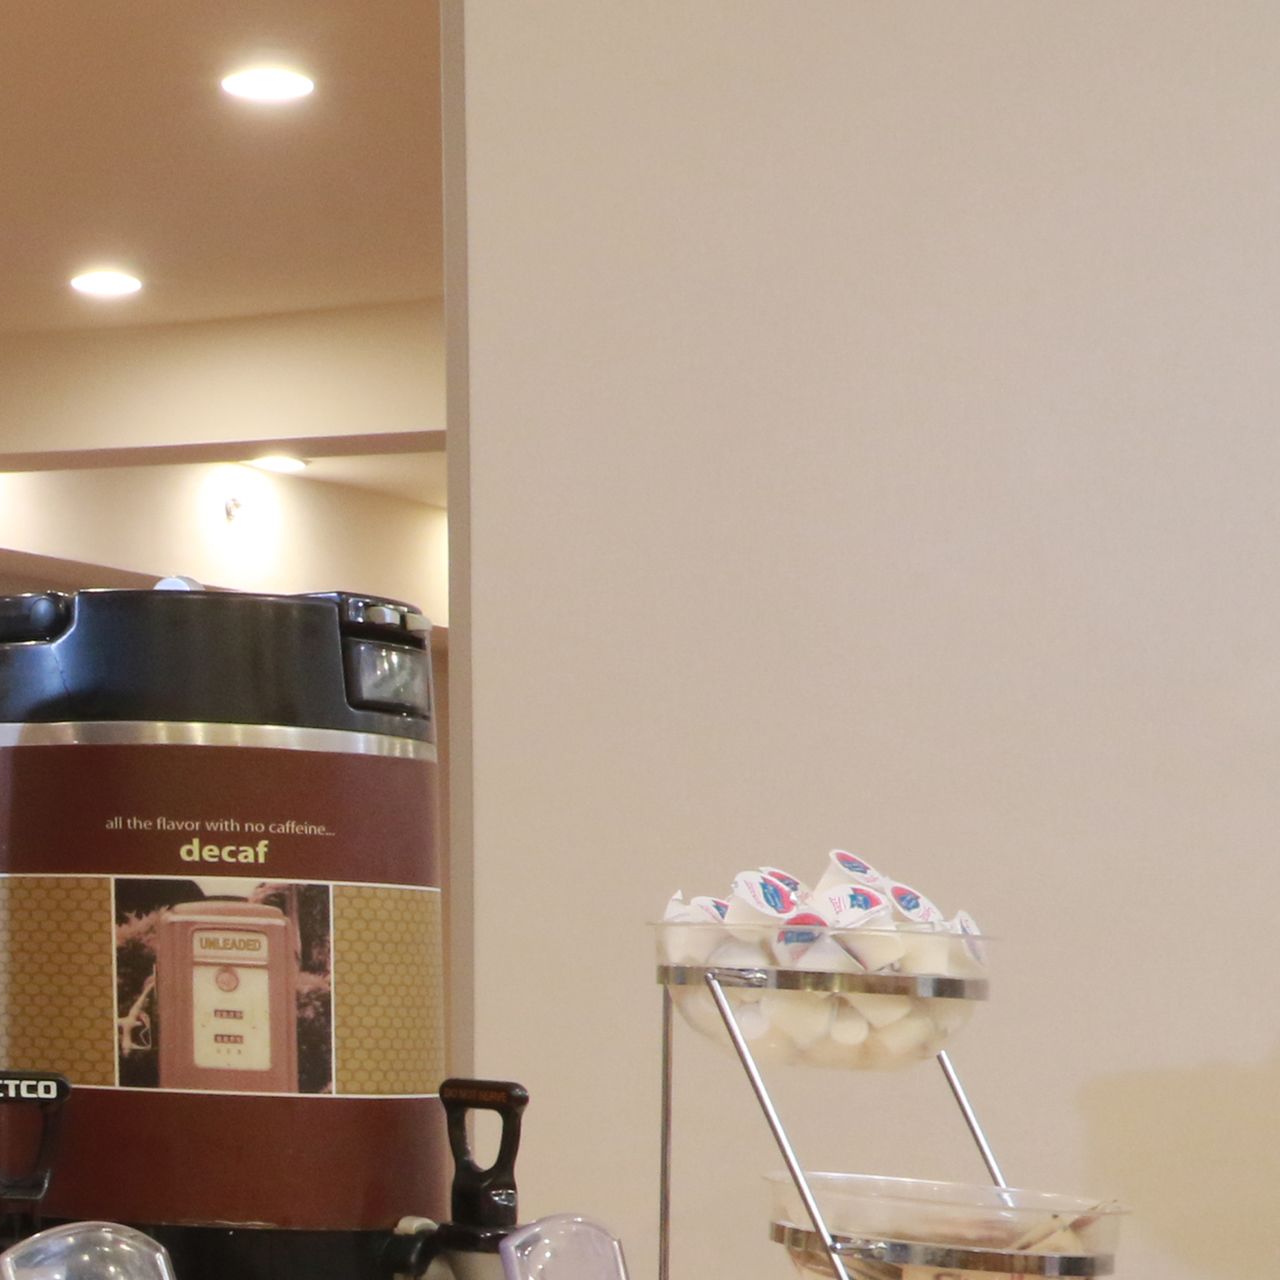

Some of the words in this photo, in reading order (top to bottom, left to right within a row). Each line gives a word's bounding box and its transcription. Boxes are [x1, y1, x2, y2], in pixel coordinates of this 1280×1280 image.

[105, 816, 122, 830] all
[127, 816, 153, 830] the
[156, 816, 201, 831] flavor
[205, 819, 241, 832] with
[244, 821, 266, 833] no
[179, 837, 269, 864] decaf
